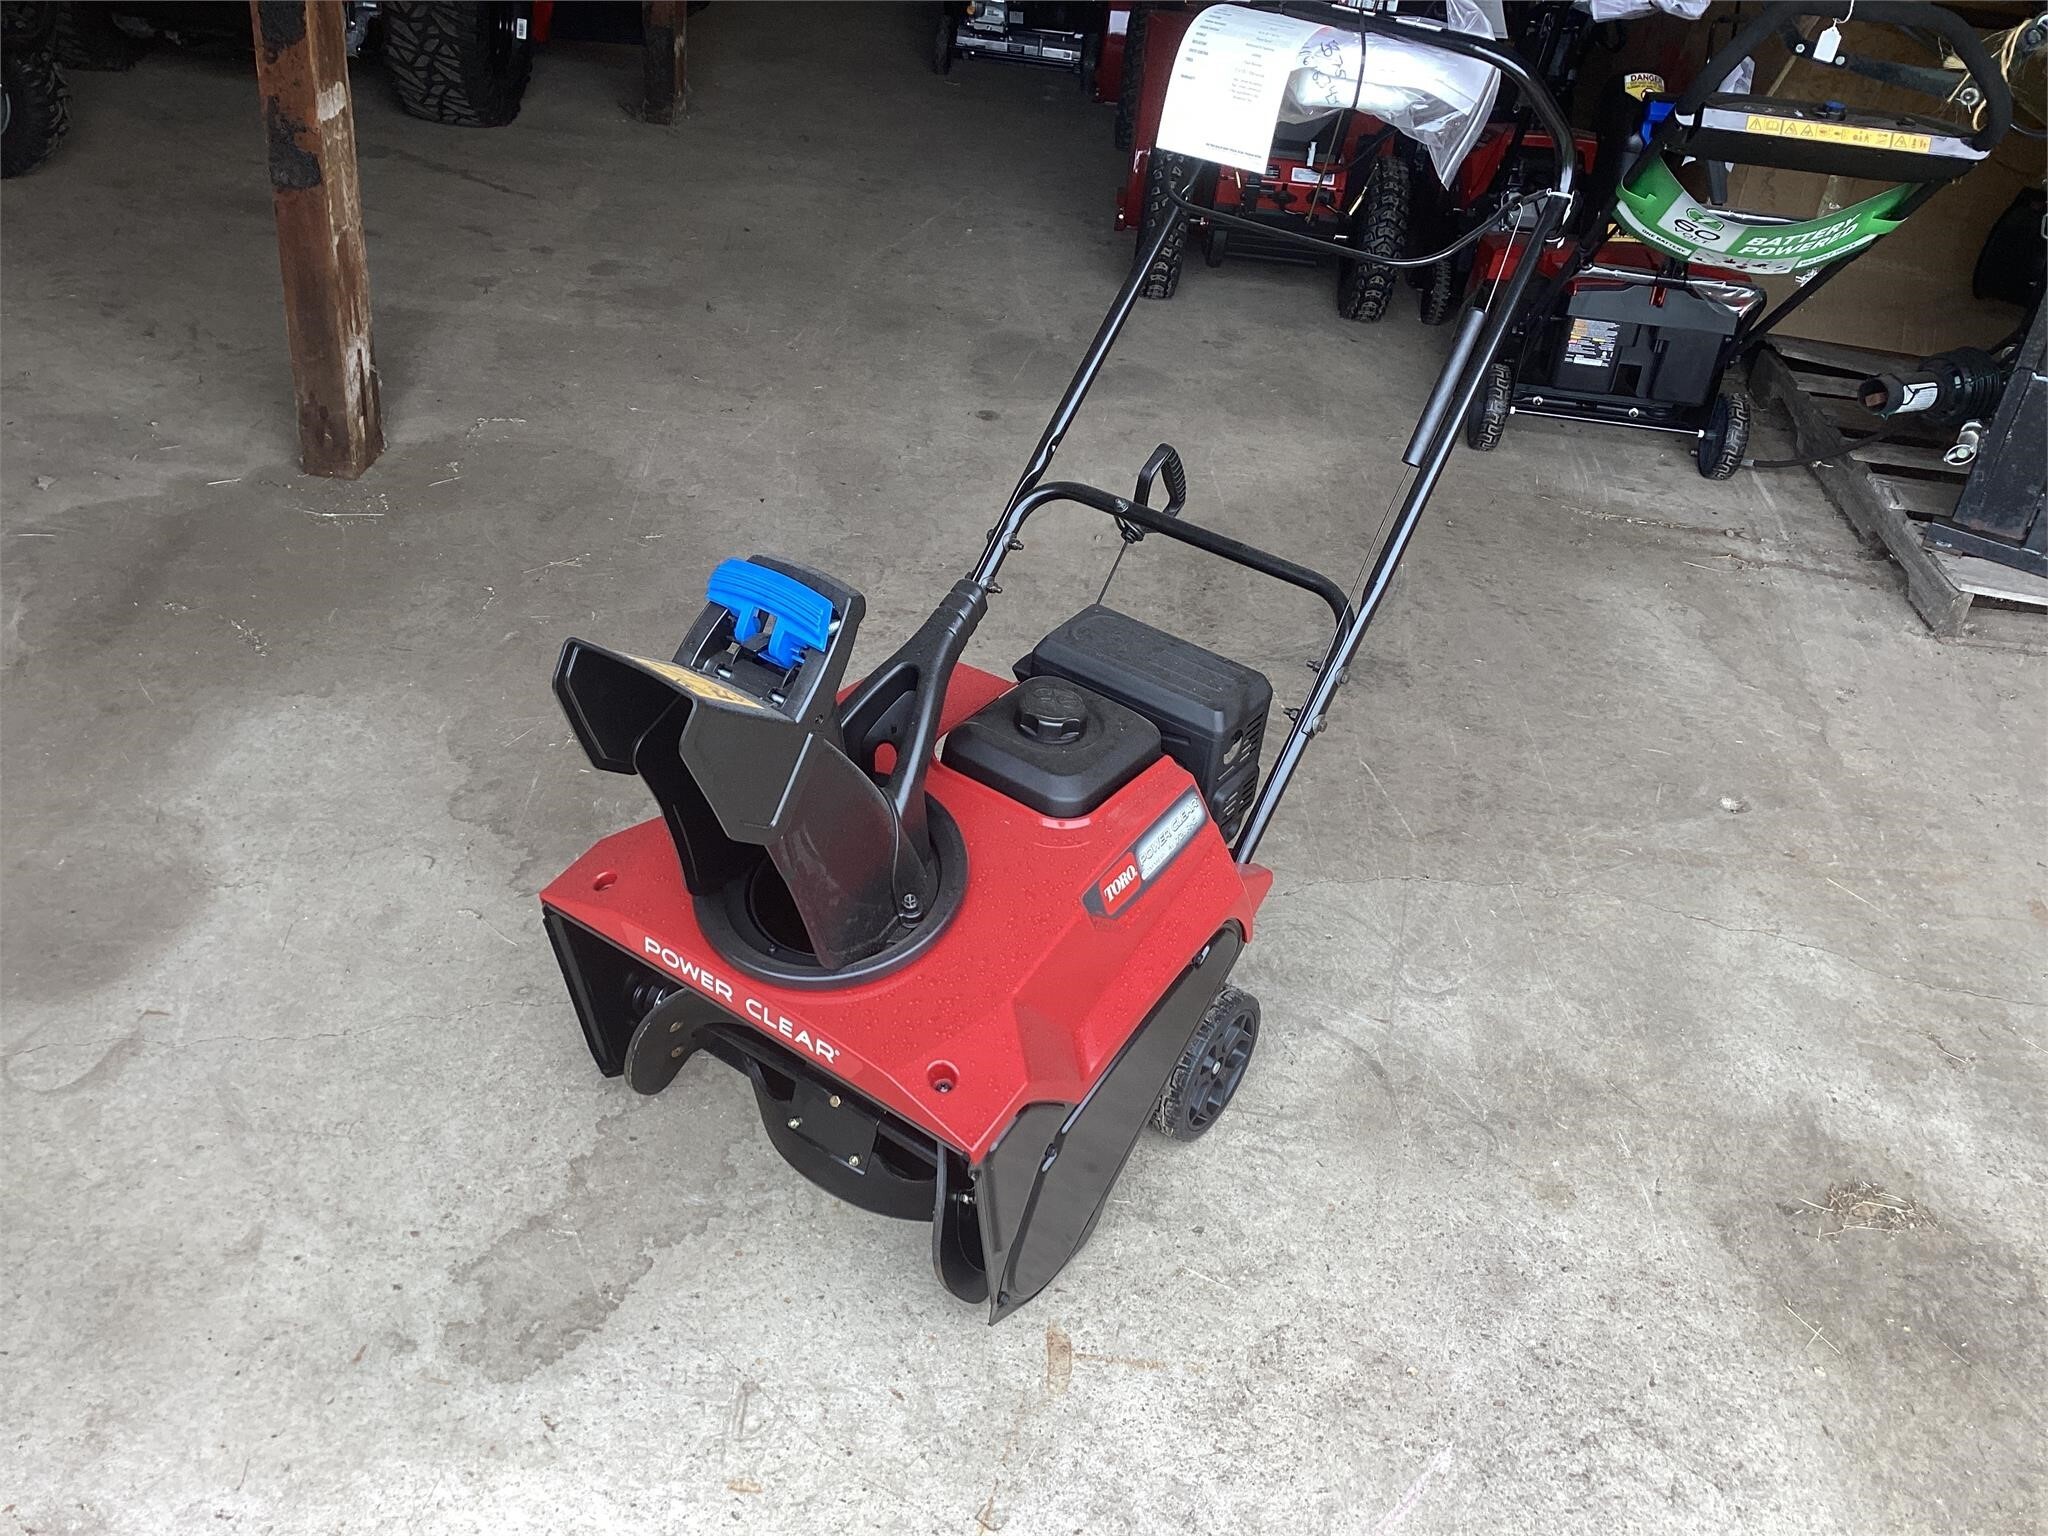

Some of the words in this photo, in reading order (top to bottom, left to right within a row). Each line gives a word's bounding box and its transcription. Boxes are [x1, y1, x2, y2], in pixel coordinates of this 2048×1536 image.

[1655, 236, 1686, 253] BATTERY
[1738, 223, 1859, 256] POWERED
[1745, 213, 1861, 246] BATTERY
[1139, 827, 1173, 866] POWER
[1171, 798, 1199, 832] CLEAR
[1103, 864, 1137, 902] TORO
[643, 936, 734, 1002] POWER
[745, 998, 836, 1065] CLEAR
